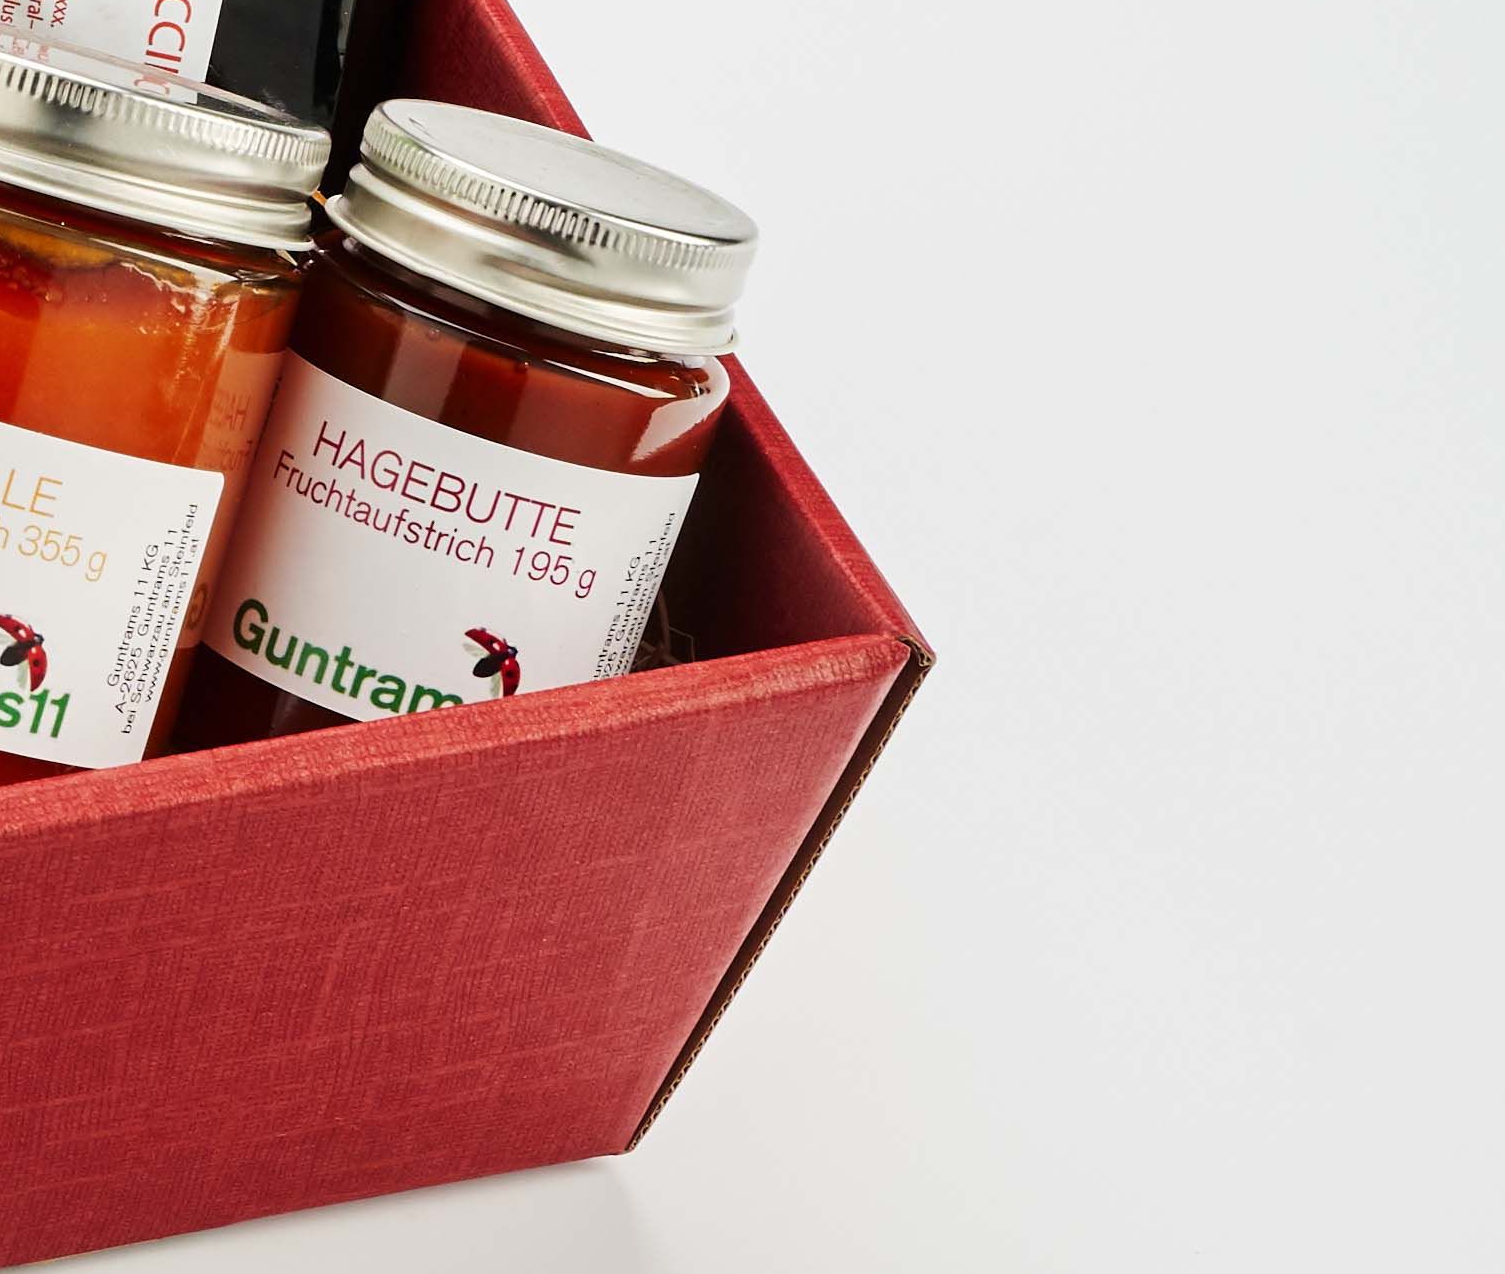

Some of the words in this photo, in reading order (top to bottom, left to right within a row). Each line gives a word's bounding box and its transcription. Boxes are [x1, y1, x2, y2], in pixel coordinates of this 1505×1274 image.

[273, 449, 495, 569] Fruchtaufstrich
[512, 545, 571, 587] 195
[574, 566, 597, 599] g
[312, 420, 582, 547] HAGEBUTTE
[17, 524, 85, 569] 355
[84, 549, 108, 582] g
[106, 605, 141, 686] Guntrams
[141, 543, 159, 571] KG
